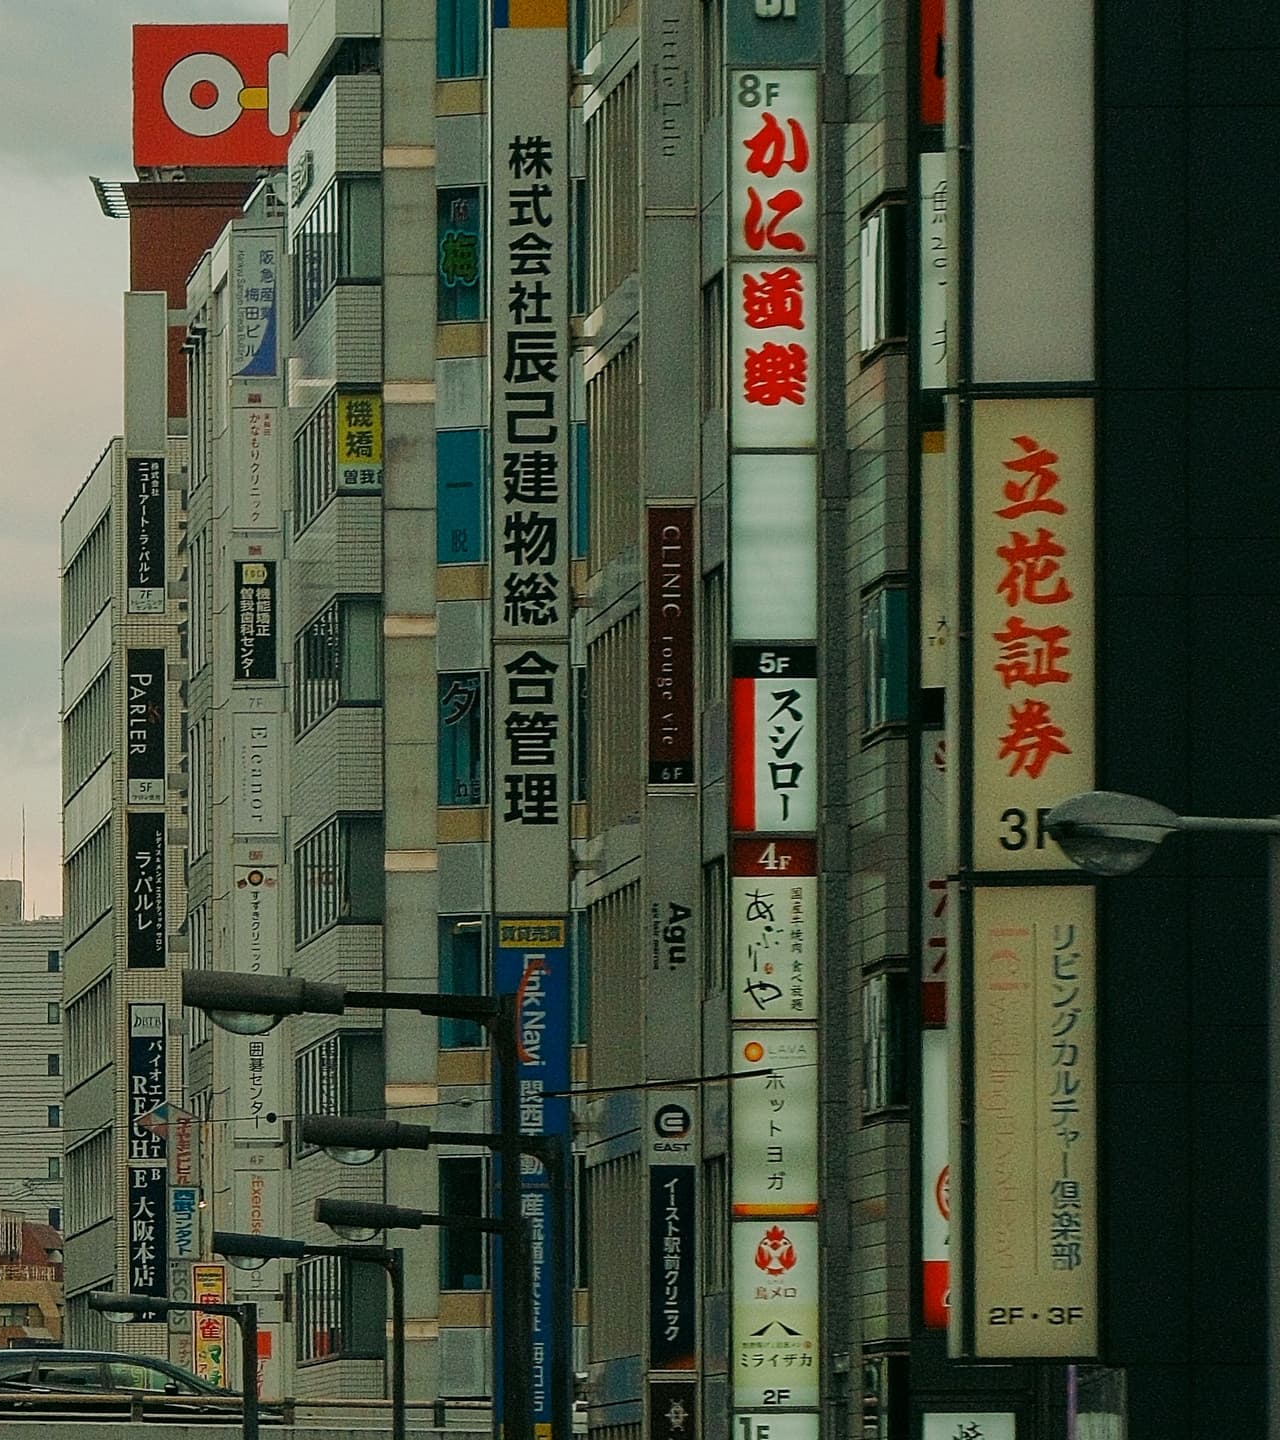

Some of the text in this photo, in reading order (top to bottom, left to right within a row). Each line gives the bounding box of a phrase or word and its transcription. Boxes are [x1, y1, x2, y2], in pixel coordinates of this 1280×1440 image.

[739, 74, 780, 108] 8F
[743, 111, 810, 406] かに道楽
[140, 590, 152, 600] 7F
[661, 525, 681, 619] CLINIC
[994, 435, 1073, 779] 立花証券
[657, 634, 674, 701] rouge
[758, 652, 791, 674] 5F
[129, 673, 153, 756] PARLER
[140, 782, 152, 792] 5F
[661, 766, 683, 781] 6F
[767, 687, 804, 822] スシロー
[757, 842, 792, 871] 4F
[765, 1071, 786, 1191] ホットヨガ
[1050, 924, 1081, 1272] リビングカルチャー倶楽部
[654, 1143, 690, 1152] EAST
[132, 1196, 155, 1288] 大阪本店
[663, 1178, 682, 1342] イースト駅前クリニック
[741, 1351, 813, 1368] ミライザカ
[762, 1389, 790, 1405] 2F
